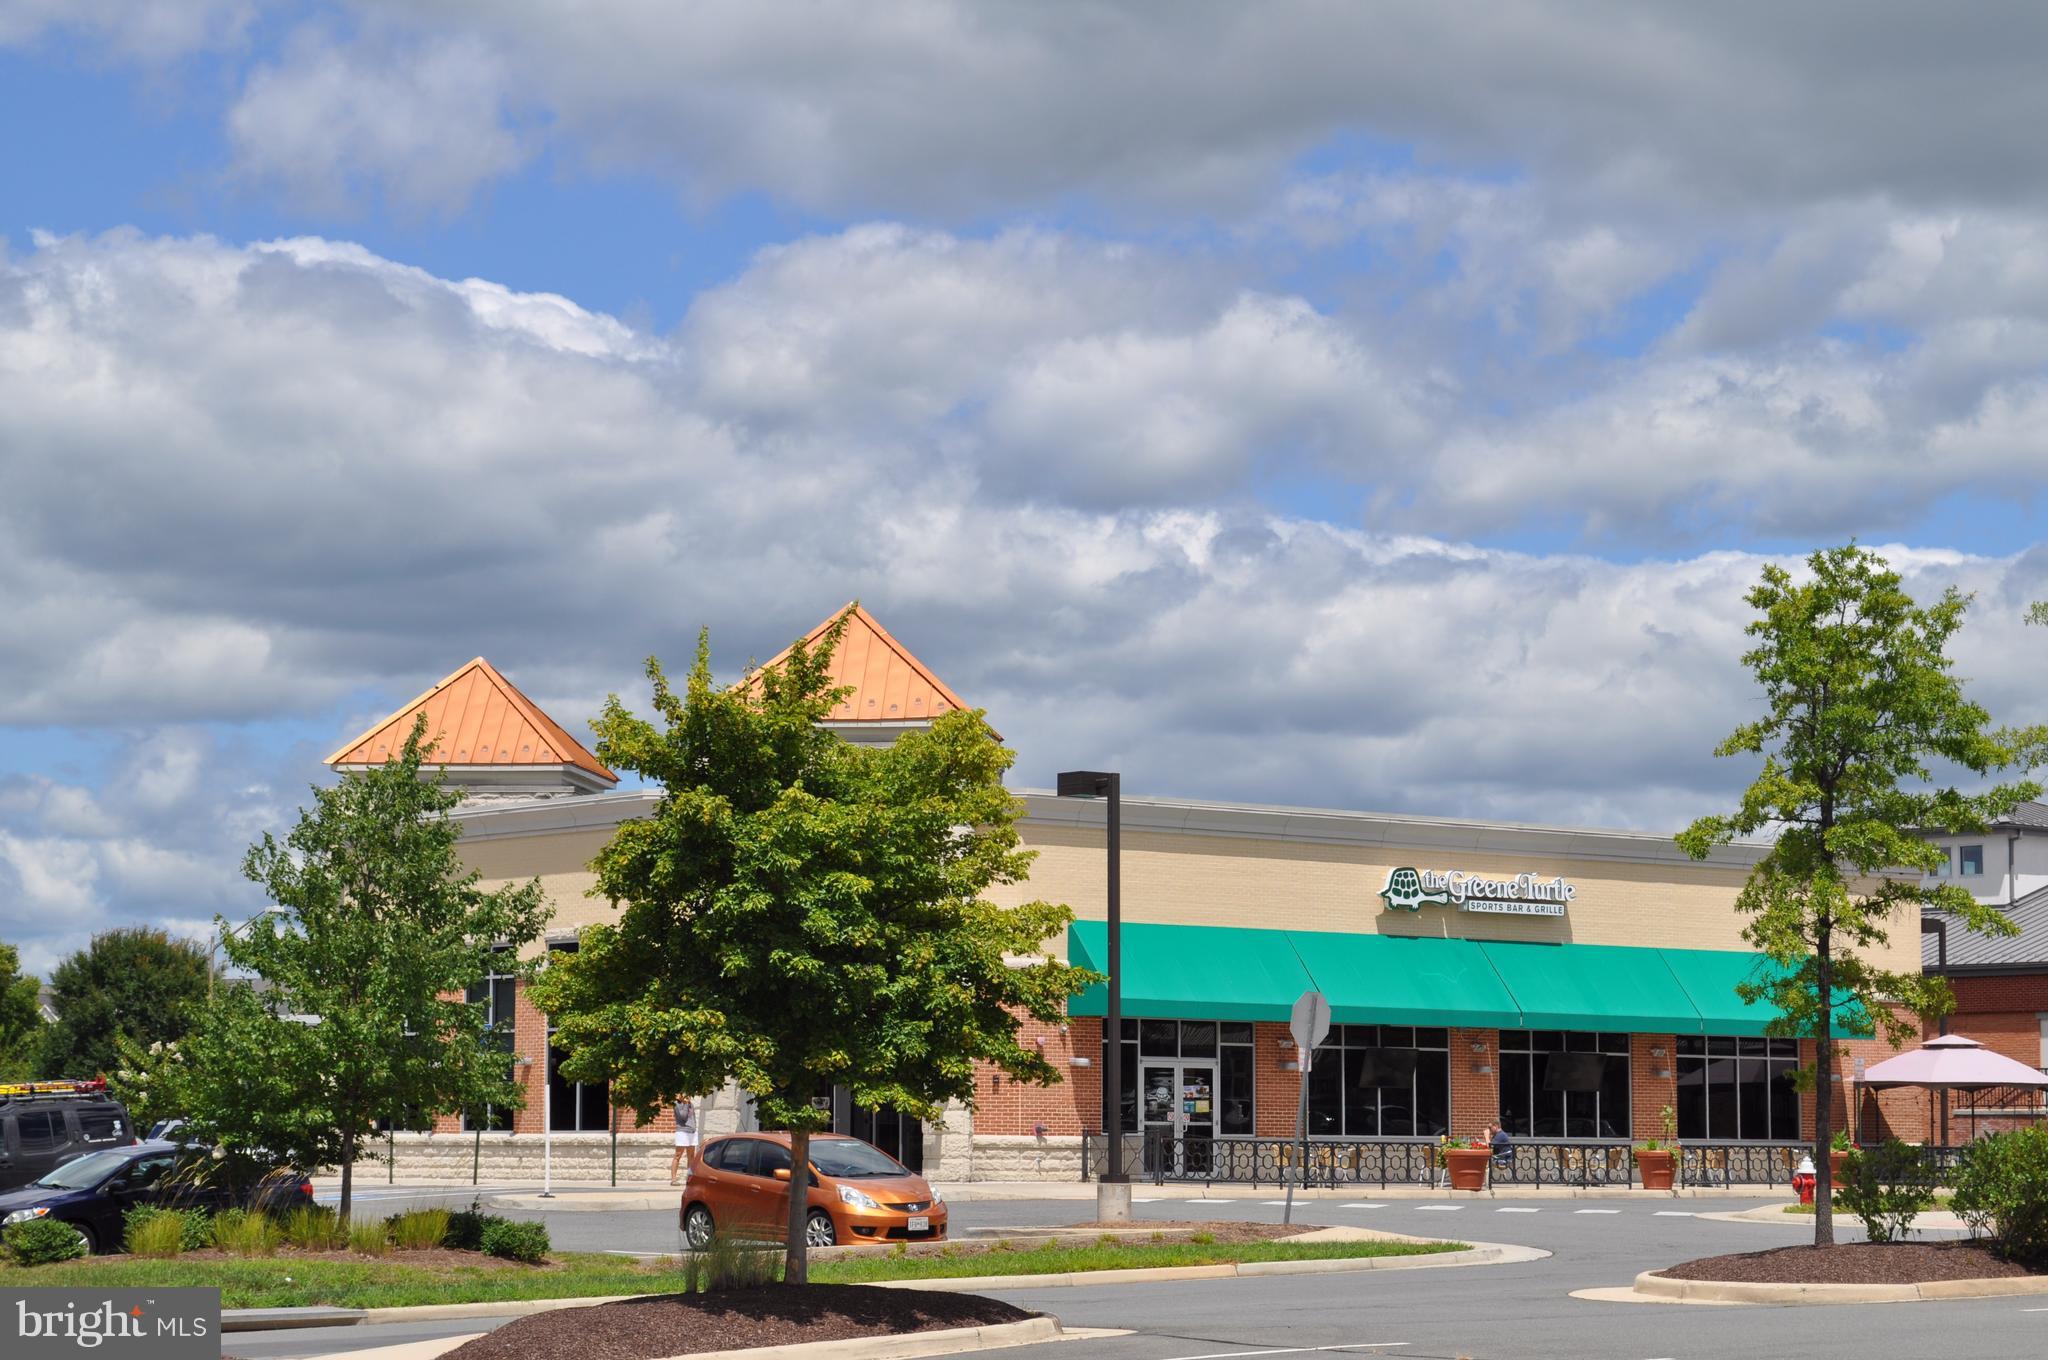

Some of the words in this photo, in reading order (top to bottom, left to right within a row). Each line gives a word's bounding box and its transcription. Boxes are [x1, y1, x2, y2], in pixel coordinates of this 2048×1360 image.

[1424, 870, 1447, 888] the
[1448, 870, 1519, 904] Greene
[1519, 873, 1577, 902] Turtle
[1470, 901, 1503, 911] SPORTS
[1506, 904, 1524, 912] BAR
[1534, 905, 1563, 914] GRILLE
